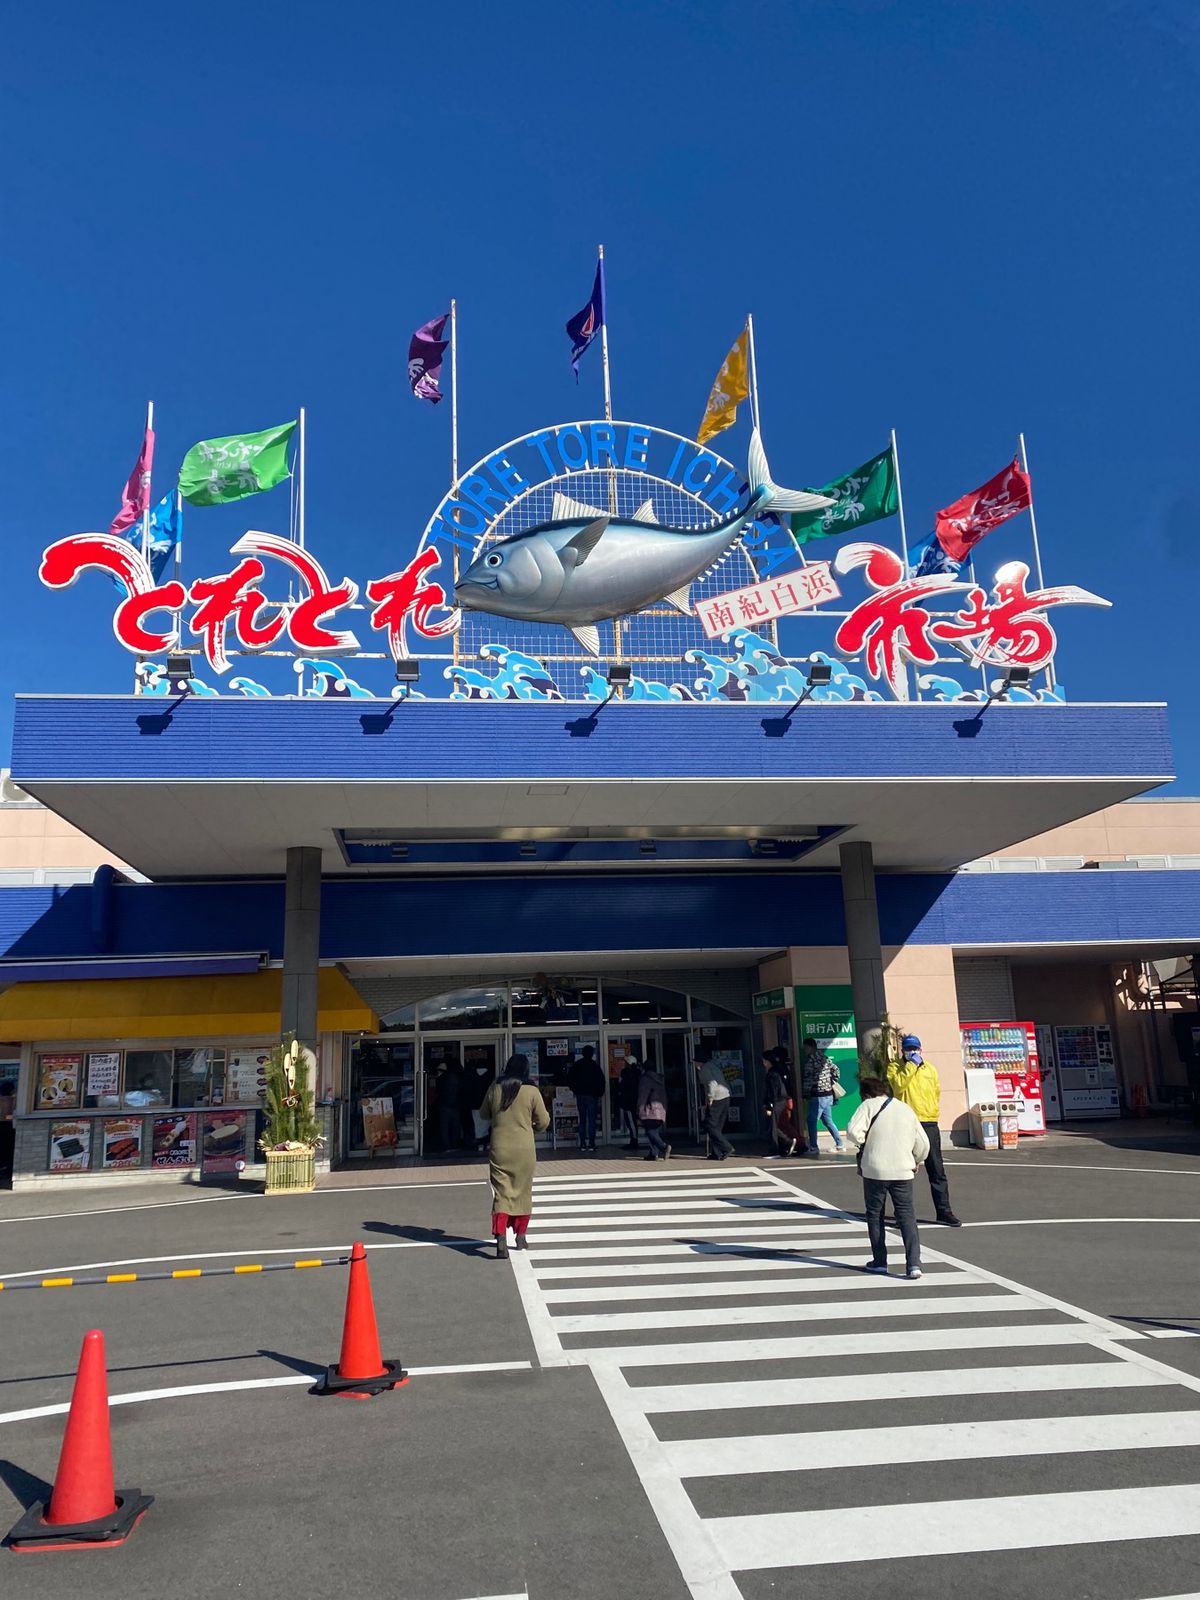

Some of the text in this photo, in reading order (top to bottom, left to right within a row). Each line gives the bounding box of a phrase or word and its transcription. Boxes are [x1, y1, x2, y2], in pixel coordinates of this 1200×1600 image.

[427, 423, 798, 576] TORE TORE ICHBA
[39, 530, 1113, 698] とれとれ 市場
[704, 568, 834, 632] 南紀白浜
[805, 1022, 853, 1034] 銀行ATM
